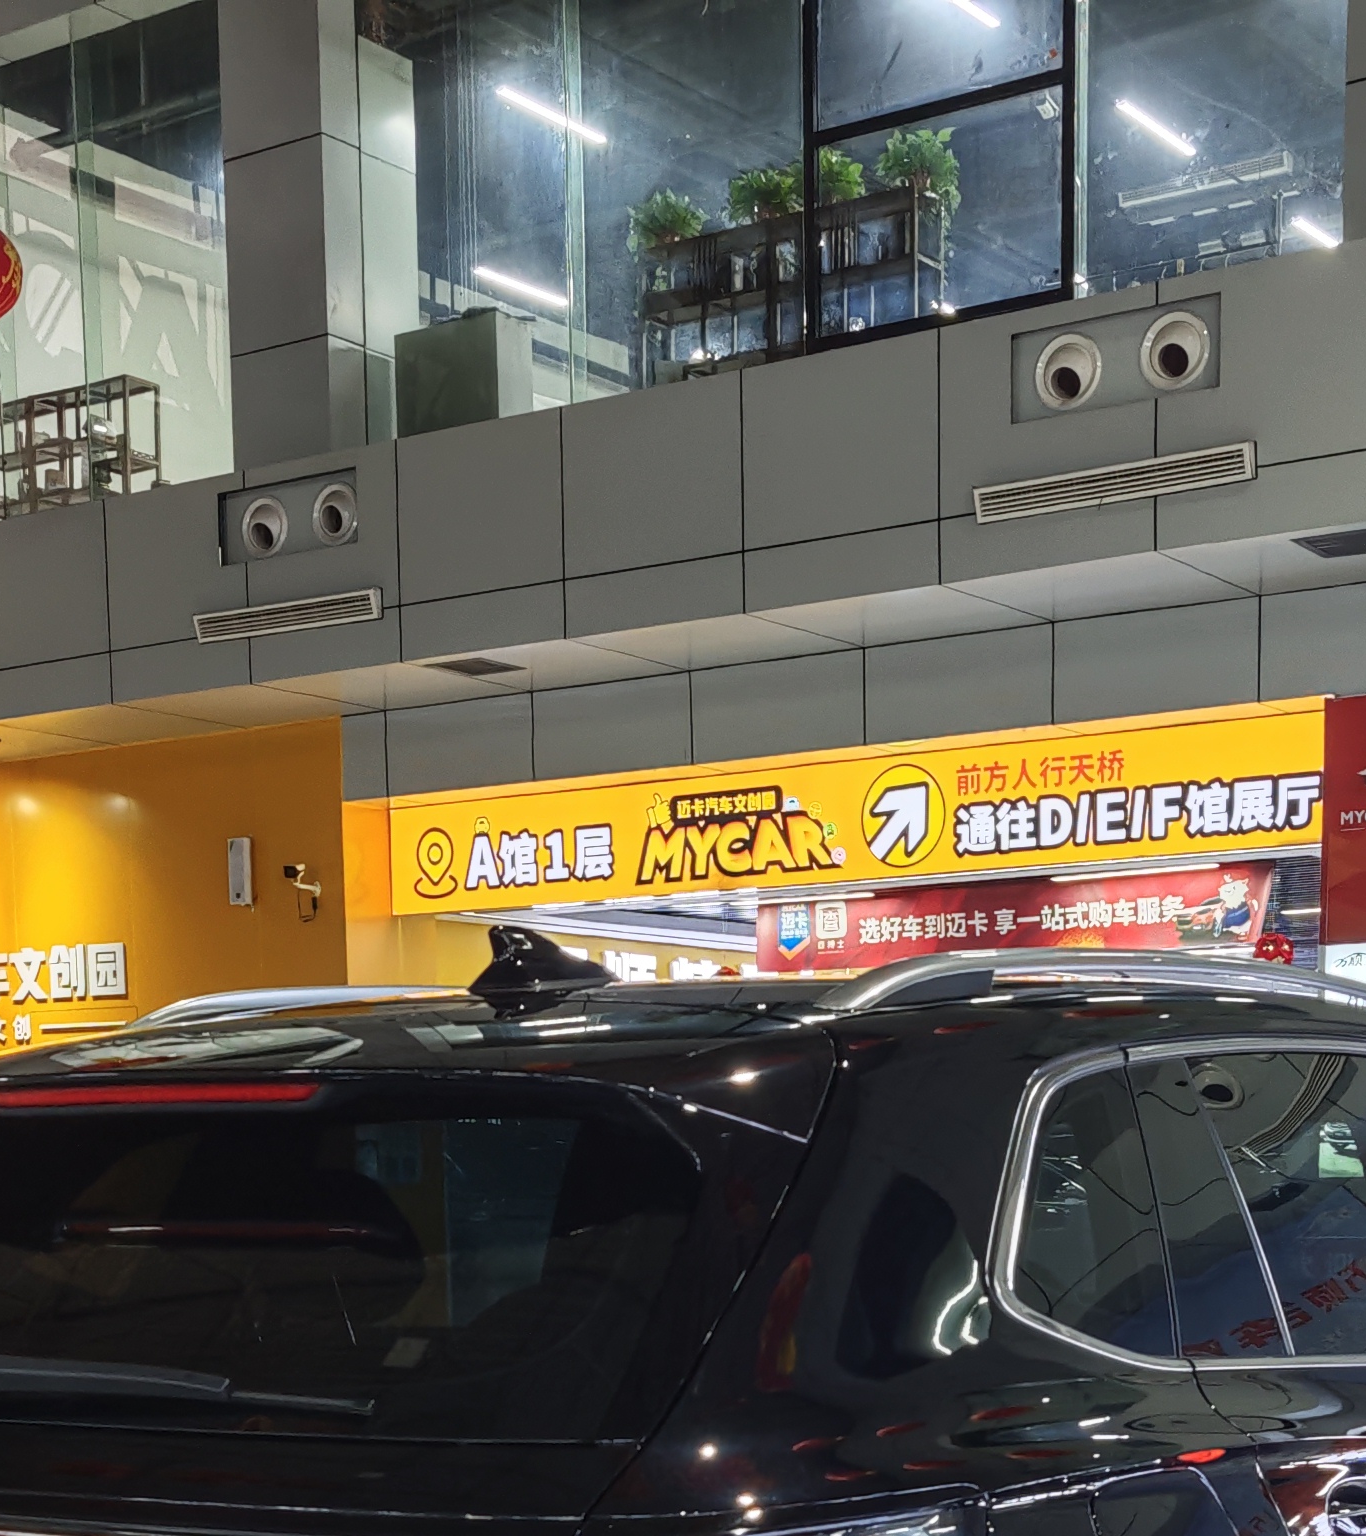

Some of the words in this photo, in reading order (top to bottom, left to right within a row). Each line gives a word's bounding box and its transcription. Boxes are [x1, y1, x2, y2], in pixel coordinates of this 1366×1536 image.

[956, 750, 1125, 796] 前方人行天桥
[677, 789, 777, 819] 迈卡汽车文创园
[956, 774, 1322, 855] 通往D/E/F馆展厅
[465, 826, 613, 891] A馆1层
[638, 812, 838, 884] MYCAR
[858, 909, 989, 945] 选好车到迈卡
[994, 895, 1185, 936] 享一站式购车服务
